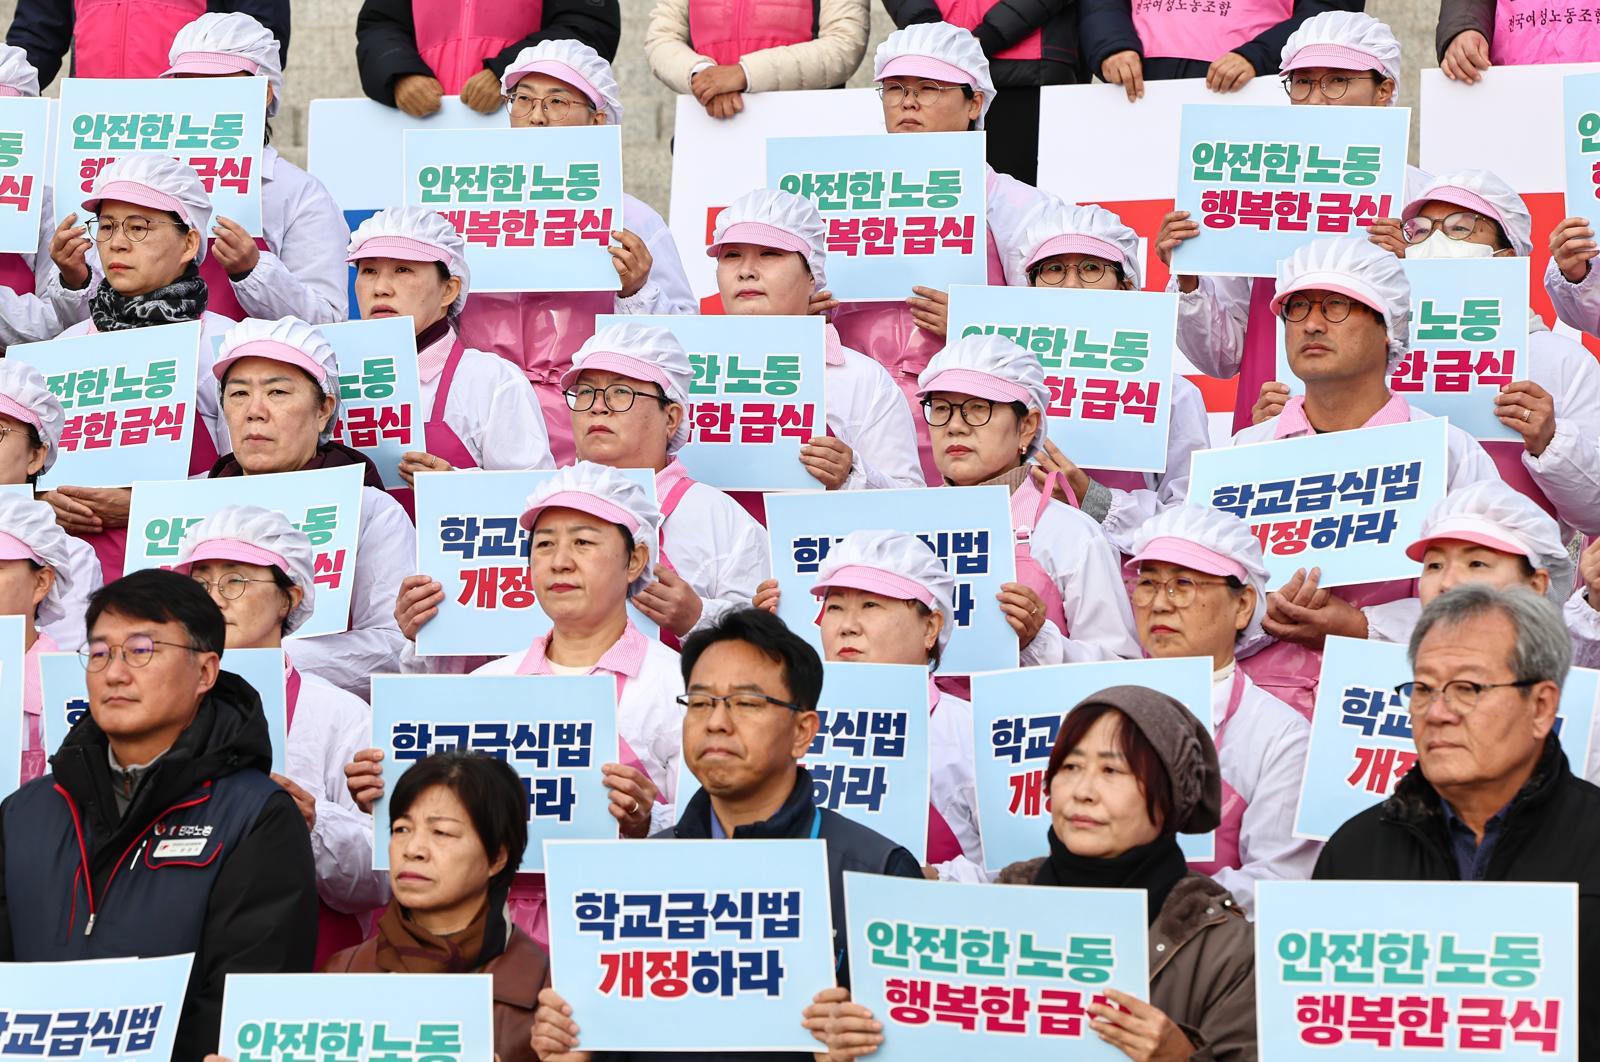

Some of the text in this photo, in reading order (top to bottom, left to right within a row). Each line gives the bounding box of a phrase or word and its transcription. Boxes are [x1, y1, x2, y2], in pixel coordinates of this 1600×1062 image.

[0, 132, 23, 168] 동
[72, 113, 244, 150] 안전한 노동
[418, 163, 601, 203] 안전한 노동
[1192, 142, 1381, 186] 안전한 노동
[0, 175, 34, 212] 식
[888, 169, 962, 209] 노동
[1201, 189, 1393, 233] 행복한 급식
[543, 208, 613, 248] 급식
[823, 215, 975, 257] 복한 급식
[1417, 300, 1501, 342] 노동
[1069, 329, 1149, 373] 노동
[1433, 350, 1515, 392] 급식
[46, 359, 177, 409] 전한 노동
[724, 354, 801, 396] 노동
[1081, 378, 1160, 424] 급식
[57, 402, 186, 452] 복한 급식
[346, 403, 411, 448] 급식
[739, 403, 815, 445] 급식
[1212, 461, 1422, 519] 학교급식법
[297, 505, 337, 546] 동
[313, 549, 346, 589] 식
[392, 722, 593, 768] 학교급식법
[808, 764, 888, 812] 하라
[575, 891, 801, 941] 학교급식법
[598, 949, 784, 998] 개정하라
[866, 920, 1115, 984] 안전한 노동
[1278, 932, 1541, 988] 안전한 노동
[885, 977, 1031, 1035] 행복한
[1296, 994, 1561, 1053] 행복한 급식
[237, 1022, 462, 1062] 안전한 노동
